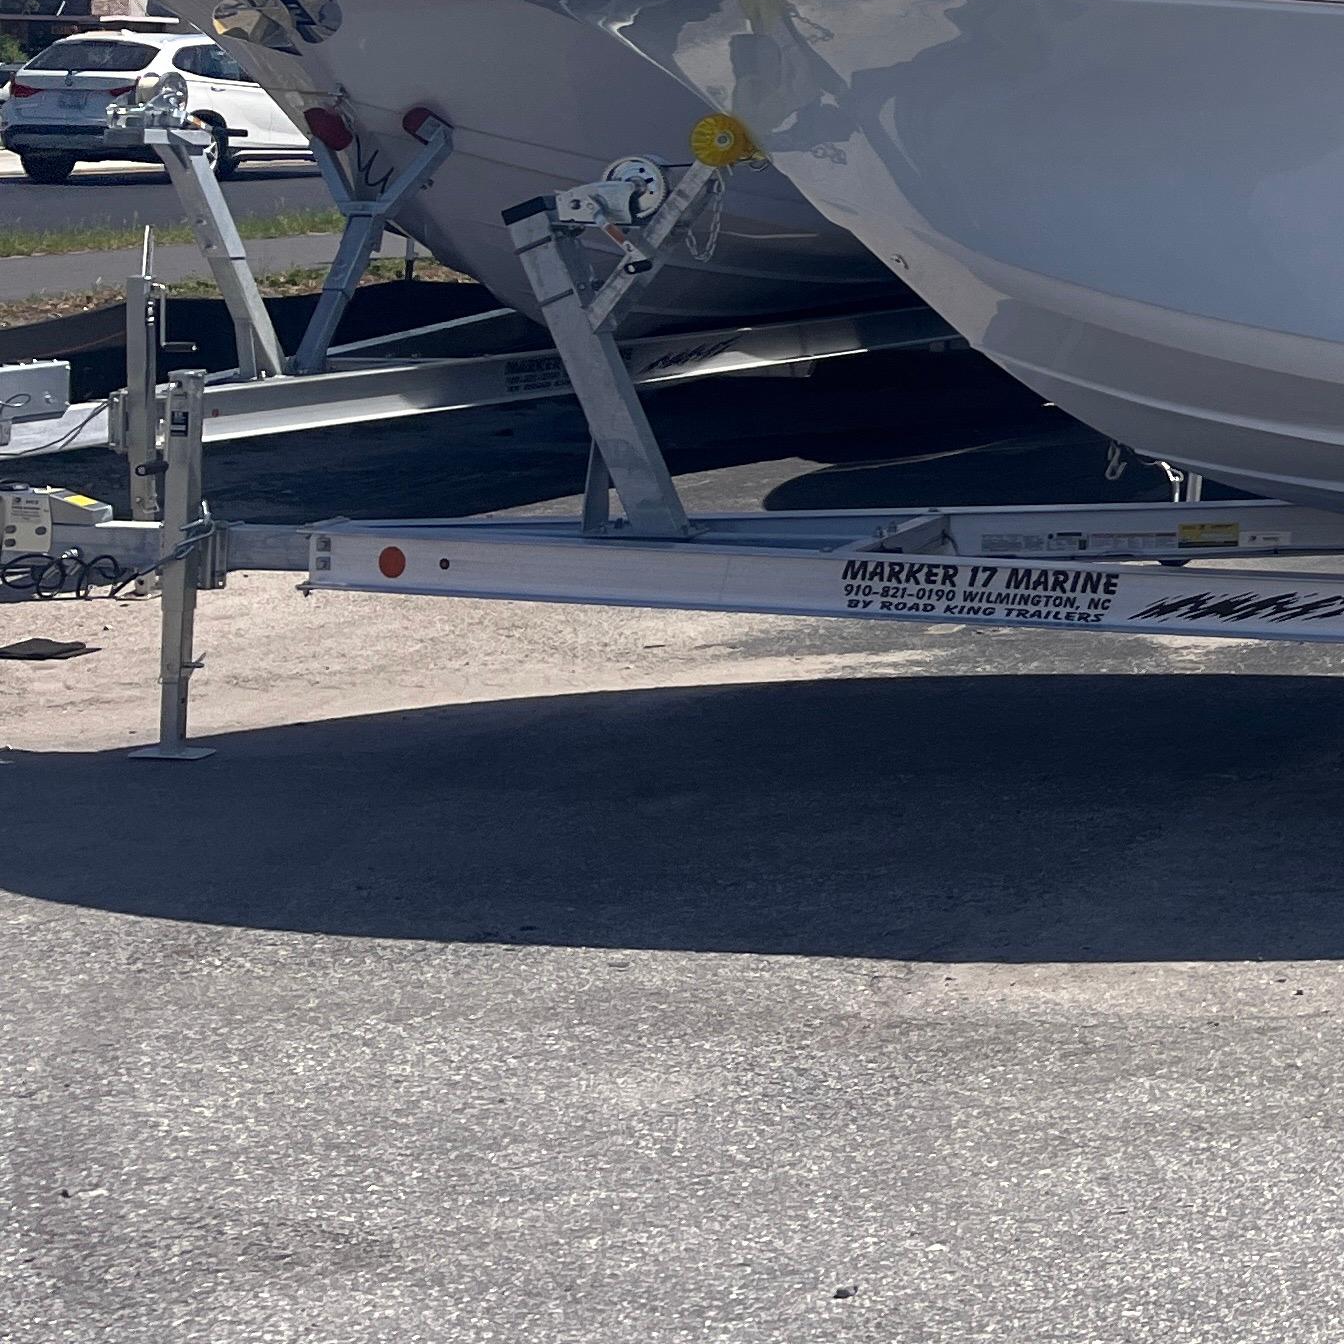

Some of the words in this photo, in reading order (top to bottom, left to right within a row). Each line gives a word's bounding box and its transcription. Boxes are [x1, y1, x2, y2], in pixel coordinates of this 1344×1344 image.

[842, 560, 959, 587] MARKER
[968, 566, 999, 588] 17
[1005, 567, 1119, 595] MARINE
[844, 584, 956, 602] 910-821-0190
[1087, 597, 1112, 611] NC
[846, 599, 874, 609] BY
[879, 601, 936, 613] ROAD
[943, 605, 996, 616] KING
[1004, 607, 1105, 623] TRAILERS
